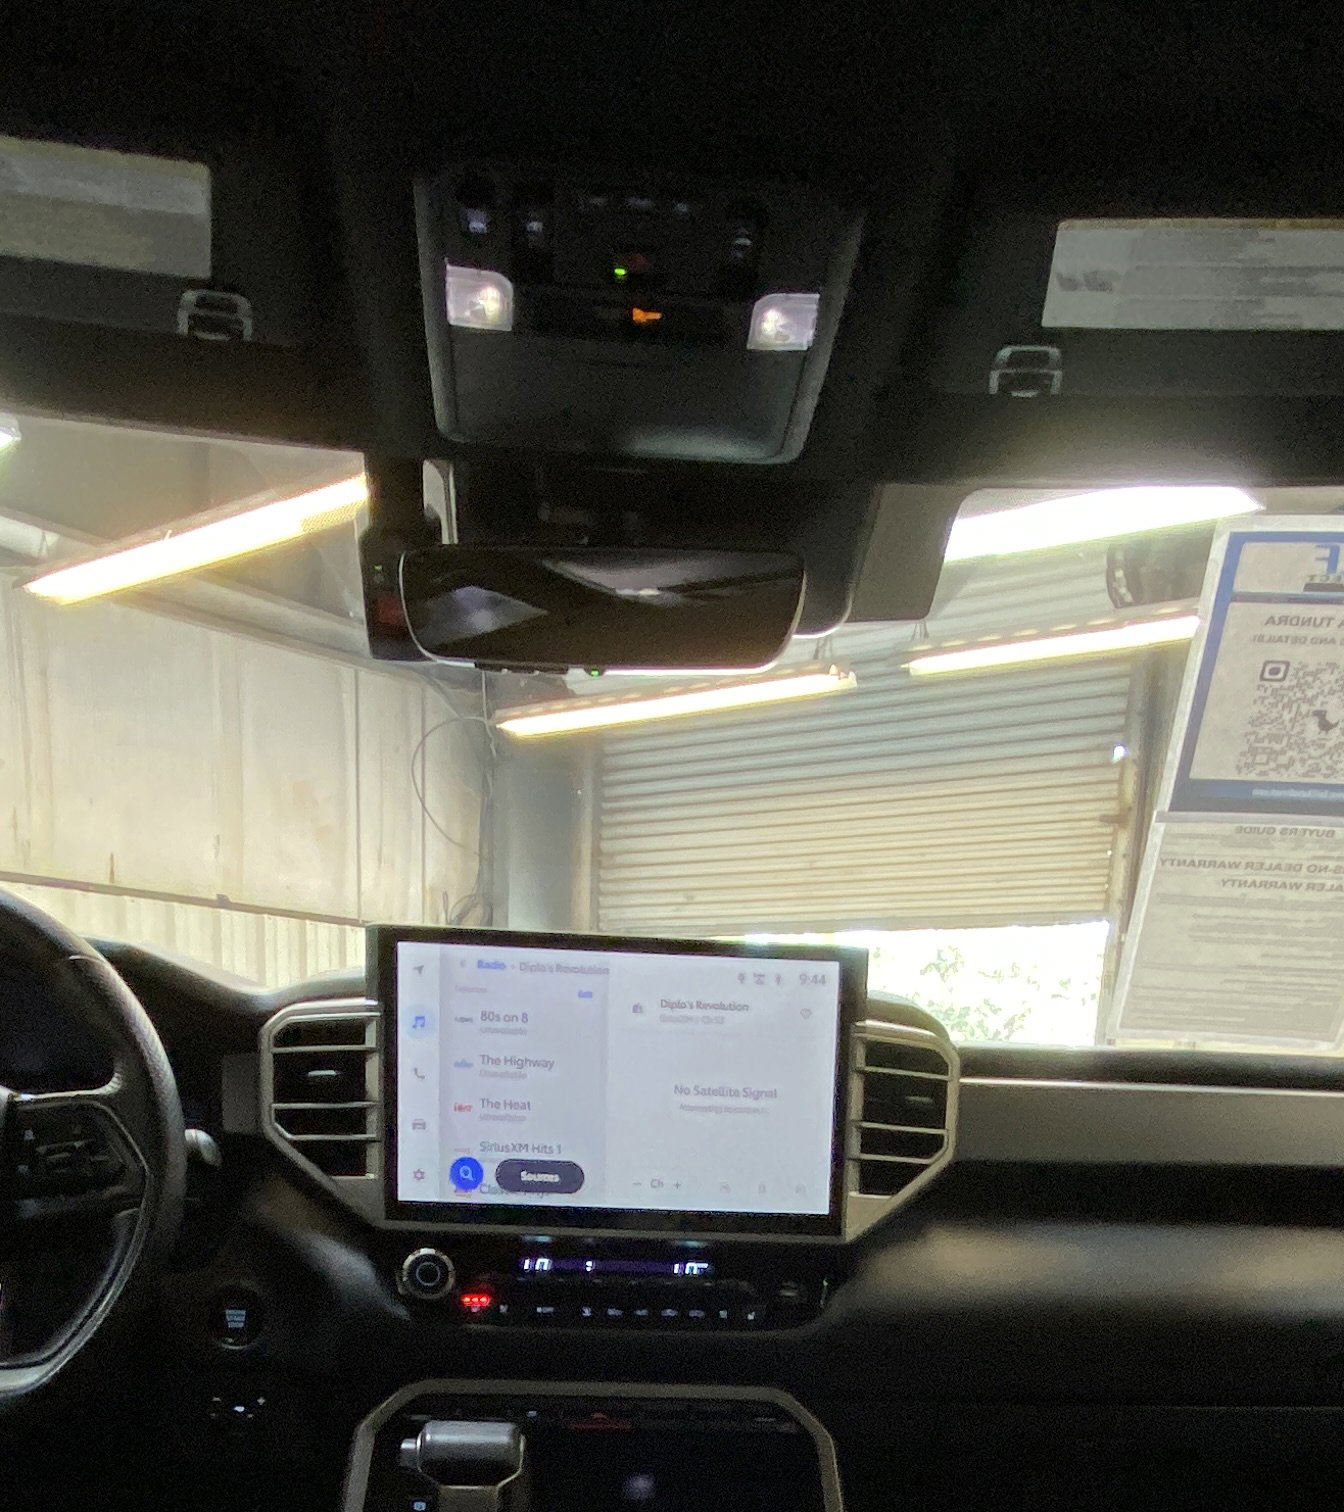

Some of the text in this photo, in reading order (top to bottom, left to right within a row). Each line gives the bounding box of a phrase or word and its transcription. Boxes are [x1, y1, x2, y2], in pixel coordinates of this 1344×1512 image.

[799, 973, 827, 986] 9:44
[695, 1001, 750, 1012] Revolution
[480, 1010, 501, 1023] 80s
[503, 1013, 519, 1023] on
[521, 1012, 529, 1024] 8
[479, 1054, 502, 1066] The
[503, 1055, 555, 1071] Highway
[674, 1084, 778, 1100] No Satellite Signal
[480, 1098, 502, 1110] The
[503, 1099, 532, 1112] Heat
[479, 1140, 529, 1154] SiriusXM
[531, 1143, 554, 1155] Hits
[556, 1144, 563, 1155] 1
